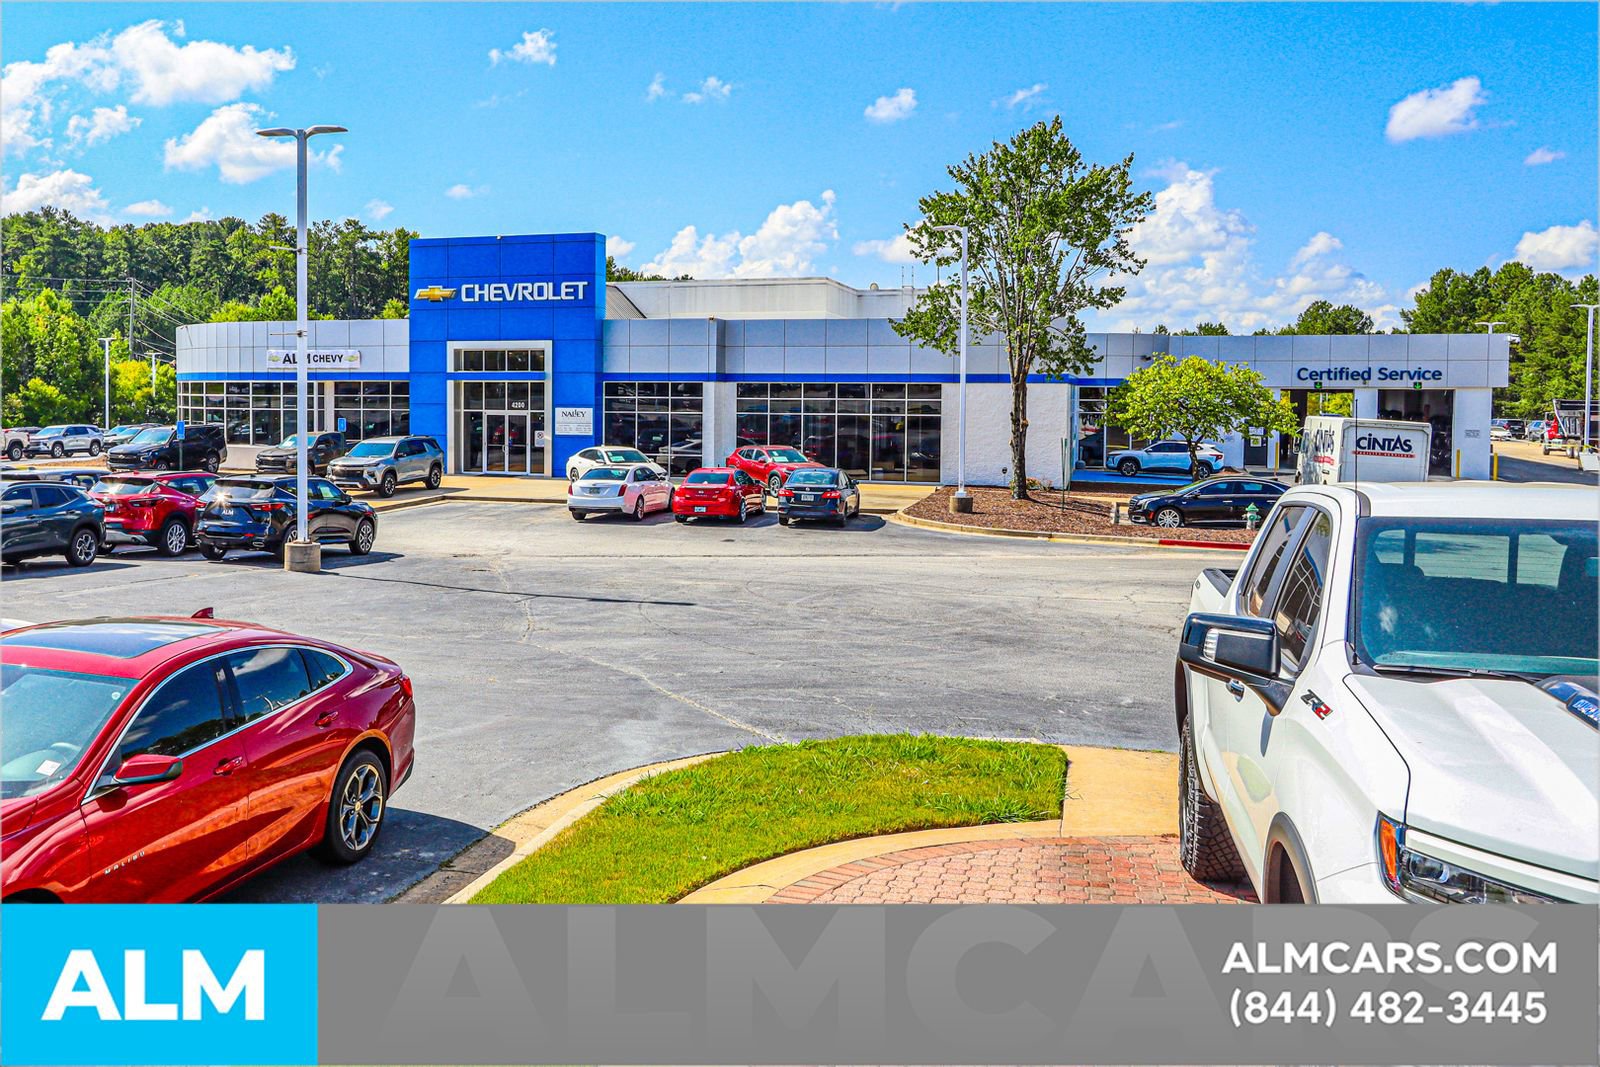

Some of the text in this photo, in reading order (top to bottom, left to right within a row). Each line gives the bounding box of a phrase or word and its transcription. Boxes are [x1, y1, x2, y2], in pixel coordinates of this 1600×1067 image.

[461, 281, 588, 302] CHEVROLET
[312, 354, 344, 363] CHEVY
[1297, 366, 1443, 381] Certified Service
[222, 508, 234, 516] ALM
[104, 851, 145, 875] MALIBU
